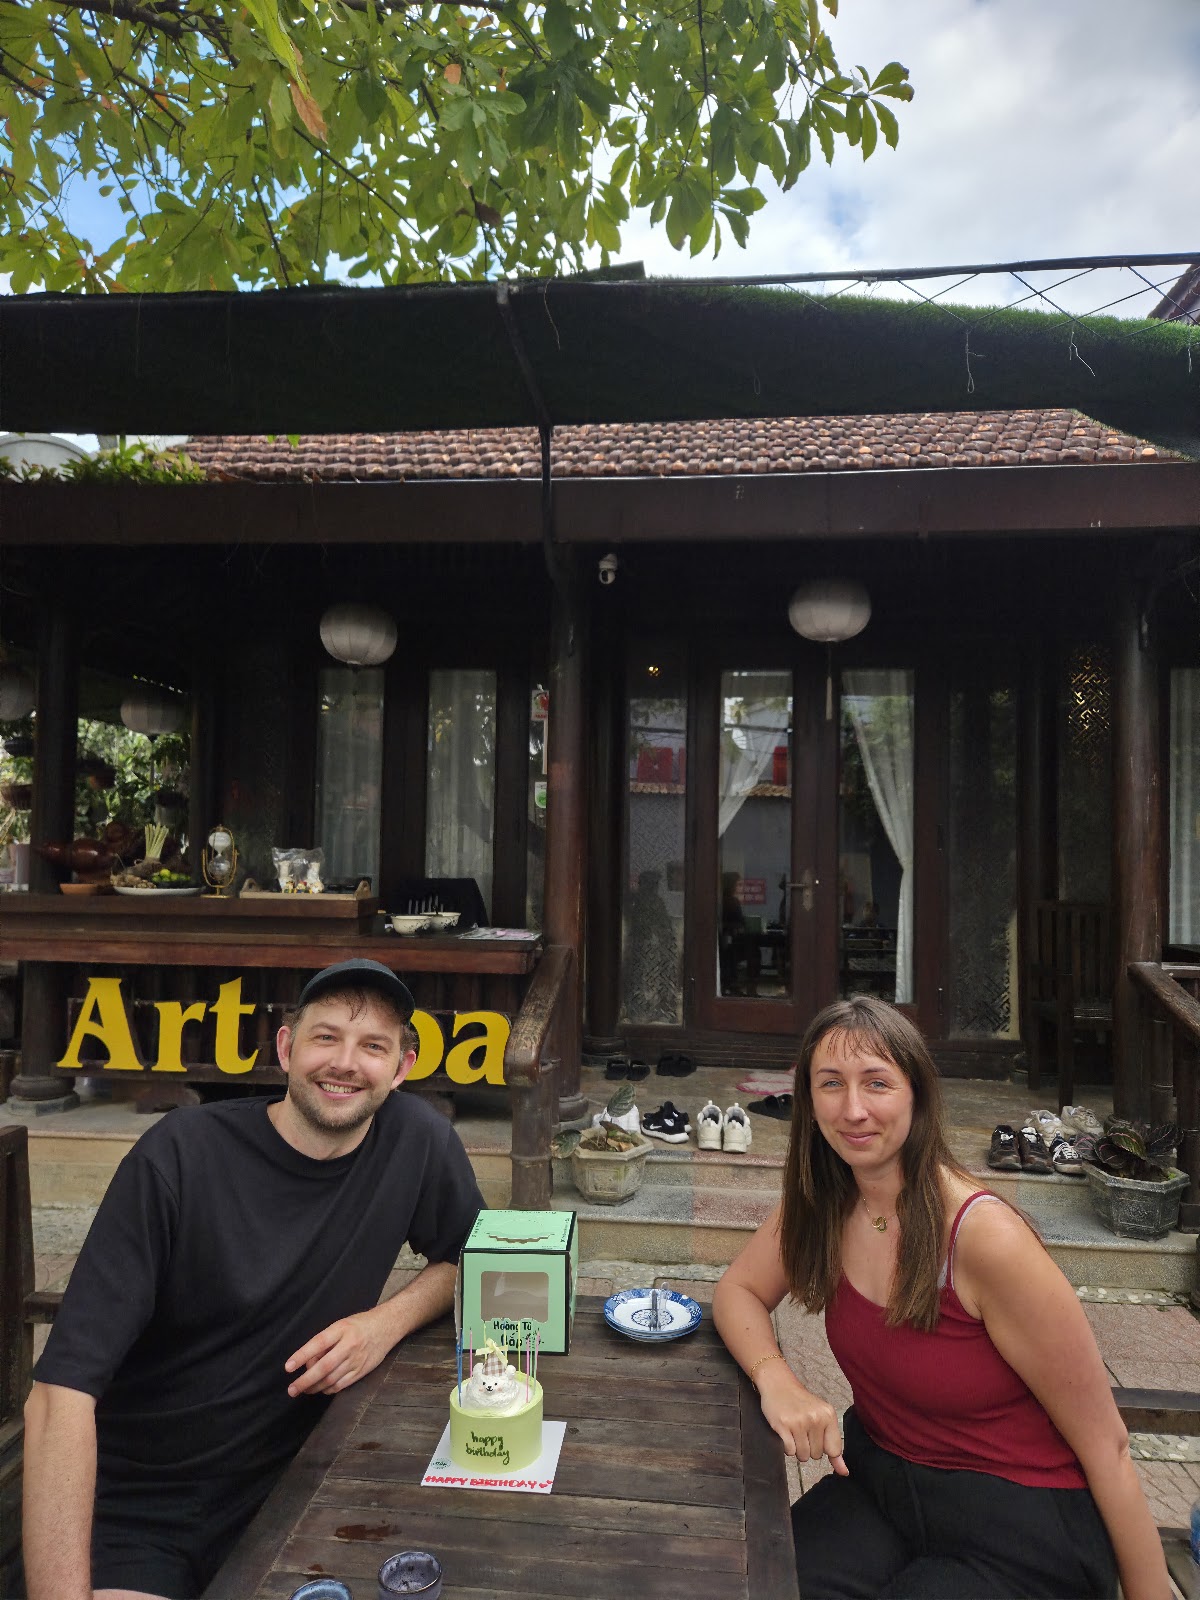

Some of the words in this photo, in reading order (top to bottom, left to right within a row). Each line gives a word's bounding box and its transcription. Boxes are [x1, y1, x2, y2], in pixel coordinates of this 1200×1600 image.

[56, 976, 259, 1074] Art
[470, 1431, 504, 1451] happy
[465, 1442, 510, 1466] birthday
[425, 1475, 469, 1486] HAPPY
[469, 1478, 537, 1489] BIRTHDAY
